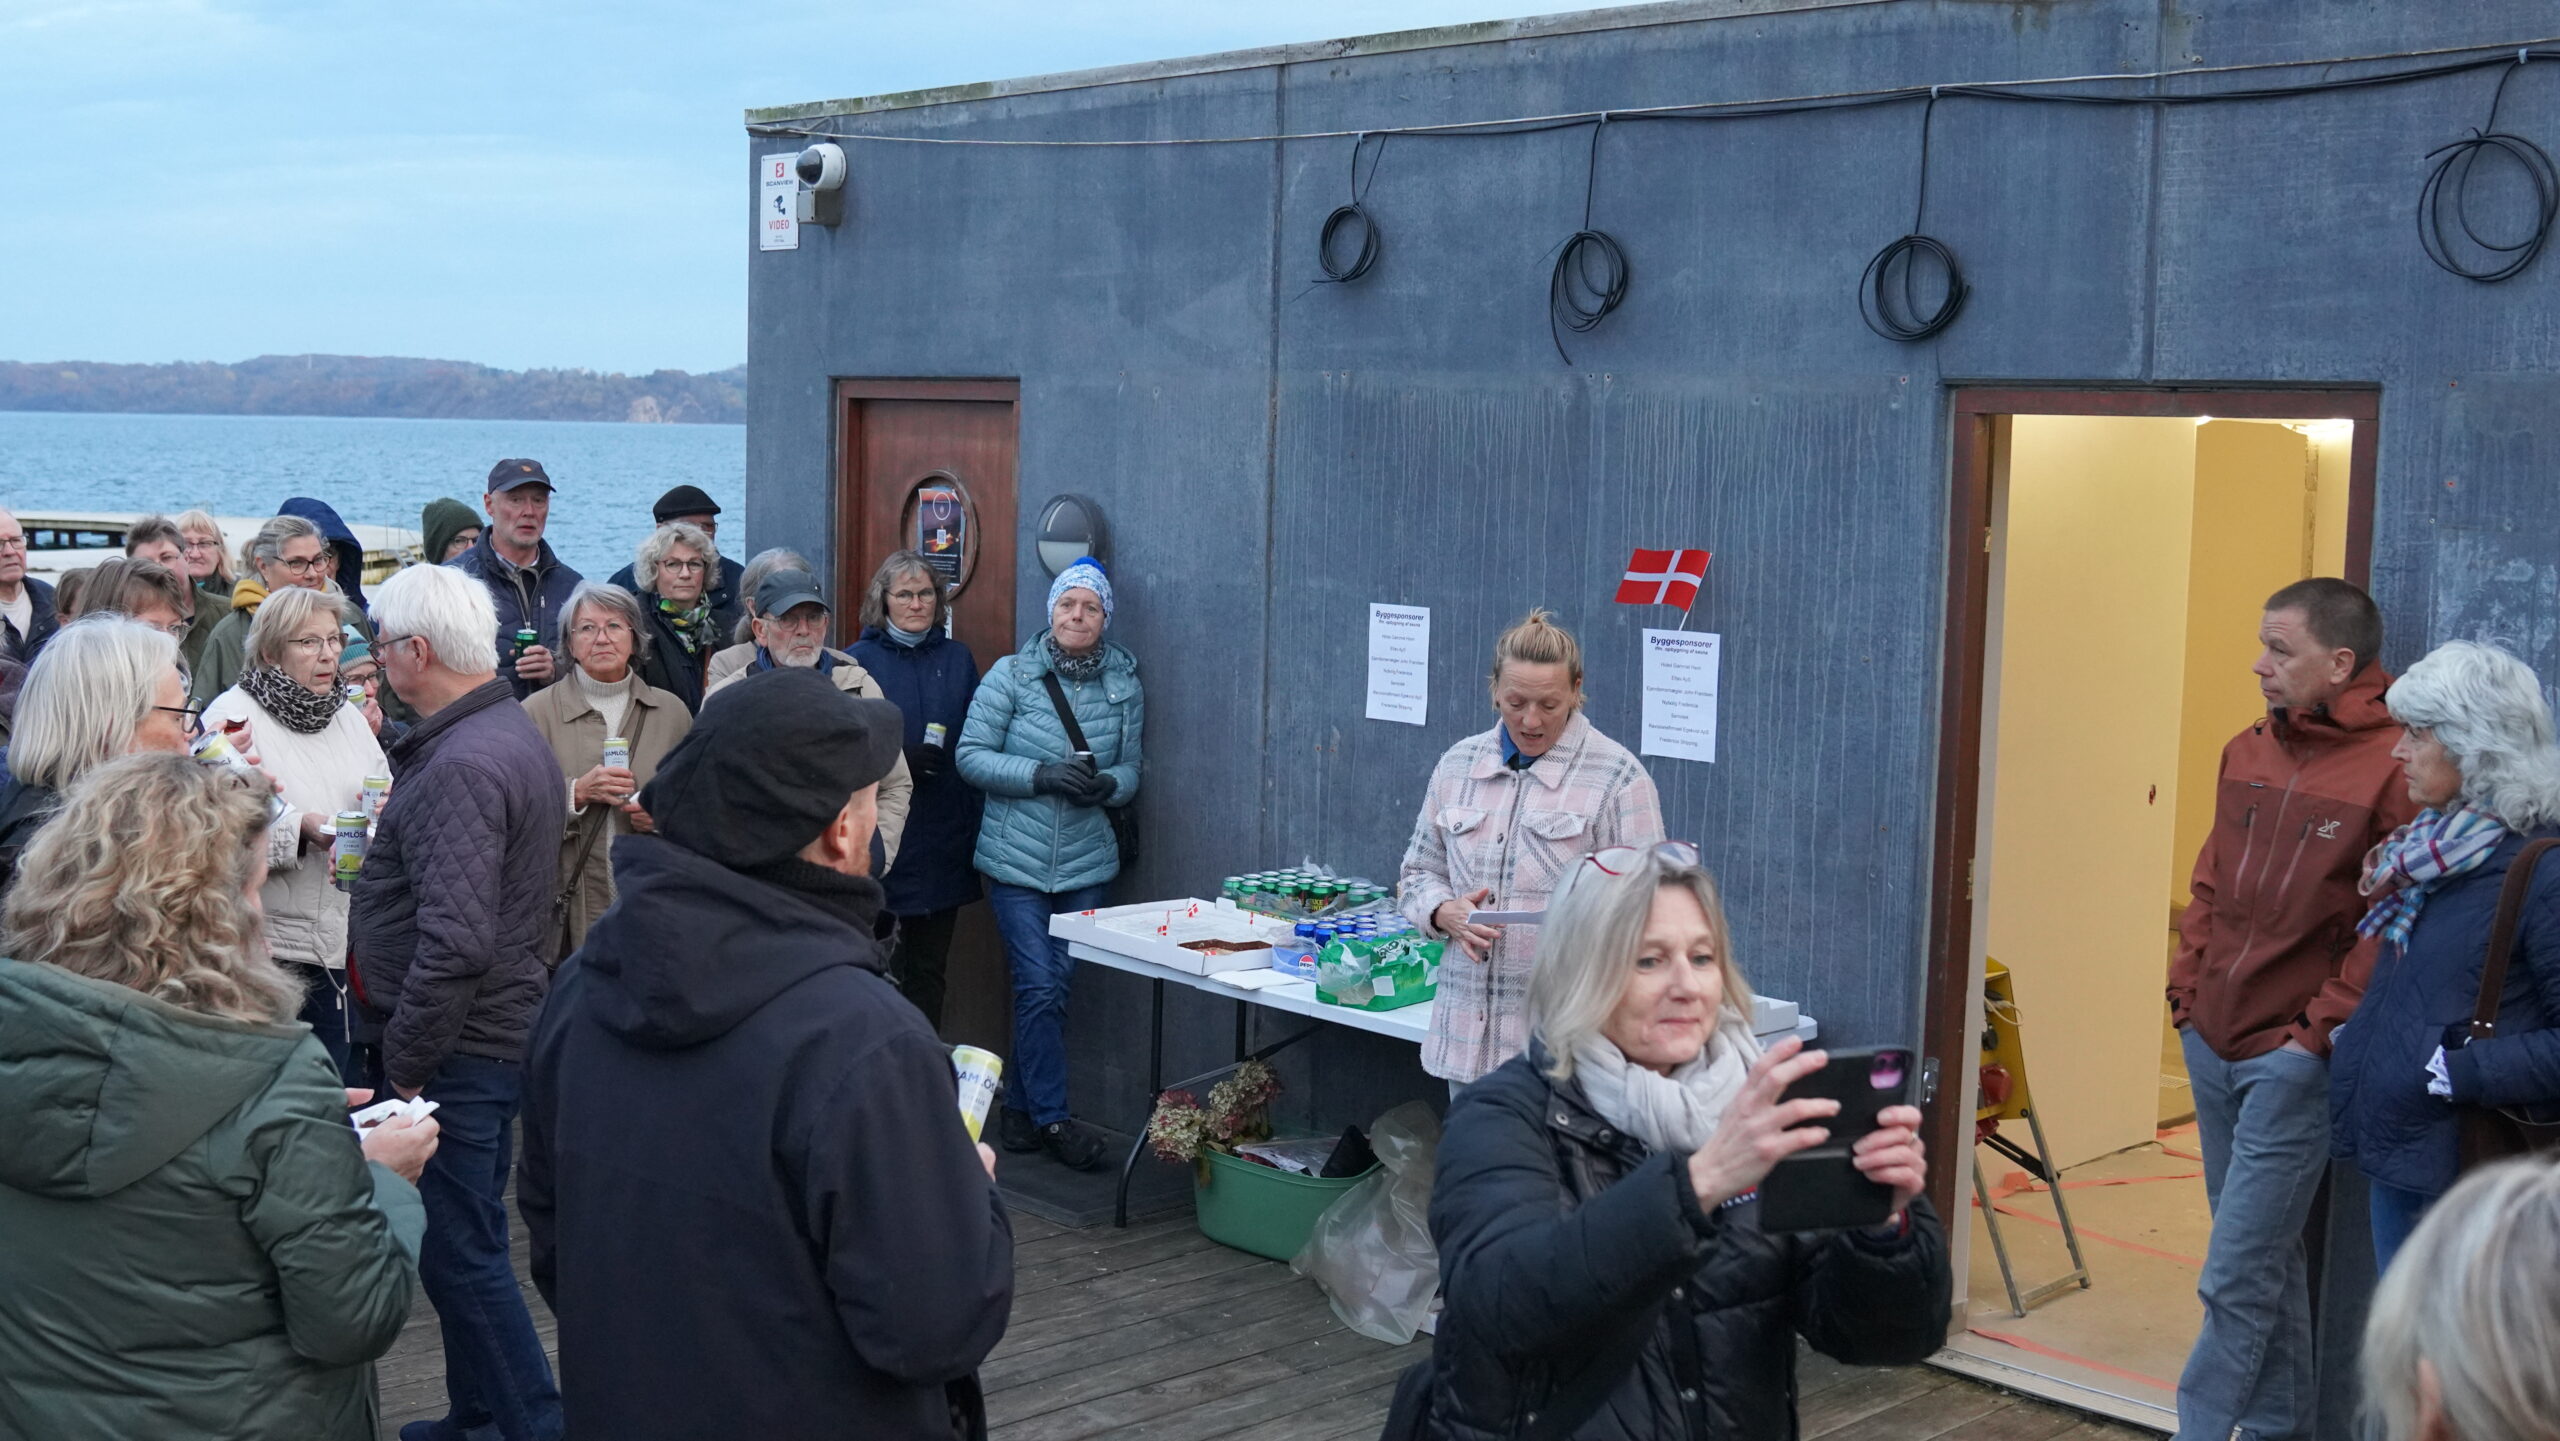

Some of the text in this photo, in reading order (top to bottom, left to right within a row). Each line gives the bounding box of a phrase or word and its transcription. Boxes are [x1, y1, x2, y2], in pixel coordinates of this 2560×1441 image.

[769, 219, 790, 230] VIDEO
[1375, 610, 1424, 620] Byggesponsorer
[1650, 636, 1713, 648] Byggesponsorer
